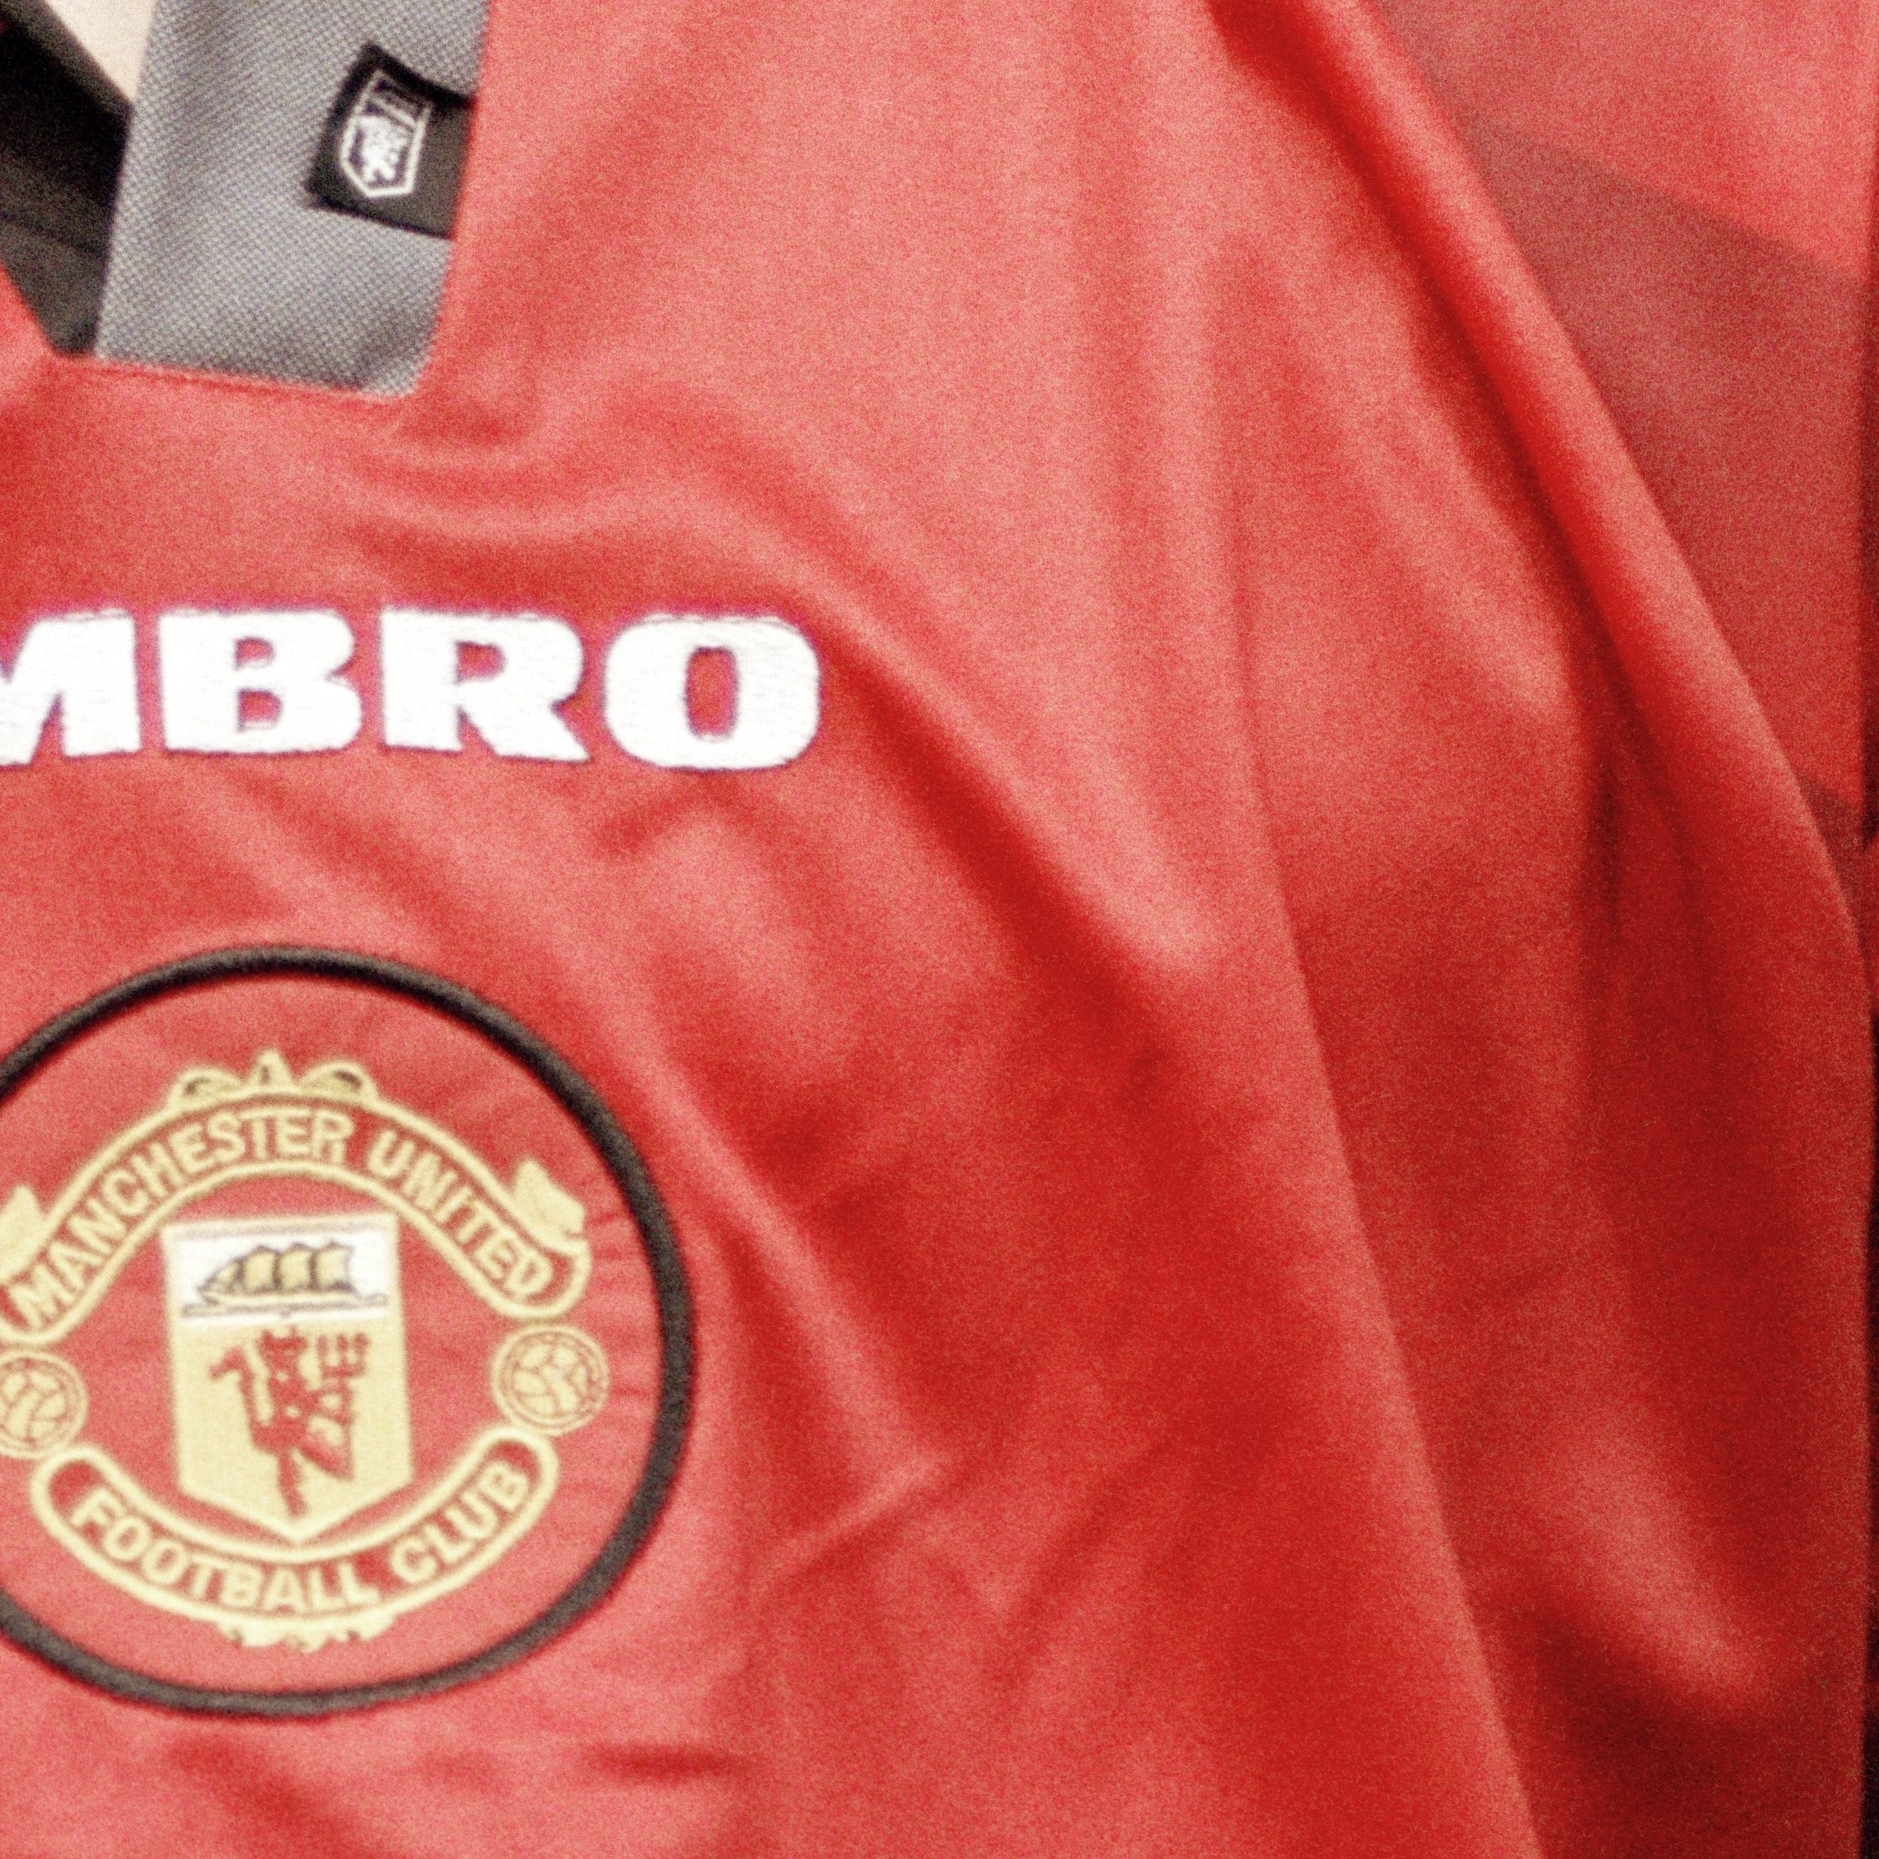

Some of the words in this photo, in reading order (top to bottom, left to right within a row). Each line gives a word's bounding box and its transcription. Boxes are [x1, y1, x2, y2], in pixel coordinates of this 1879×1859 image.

[7, 1107, 355, 1330] MANCHESTER
[367, 1130, 554, 1301] UNITED
[71, 1487, 378, 1613] FOOTBALL
[389, 1457, 530, 1583] CLUB
